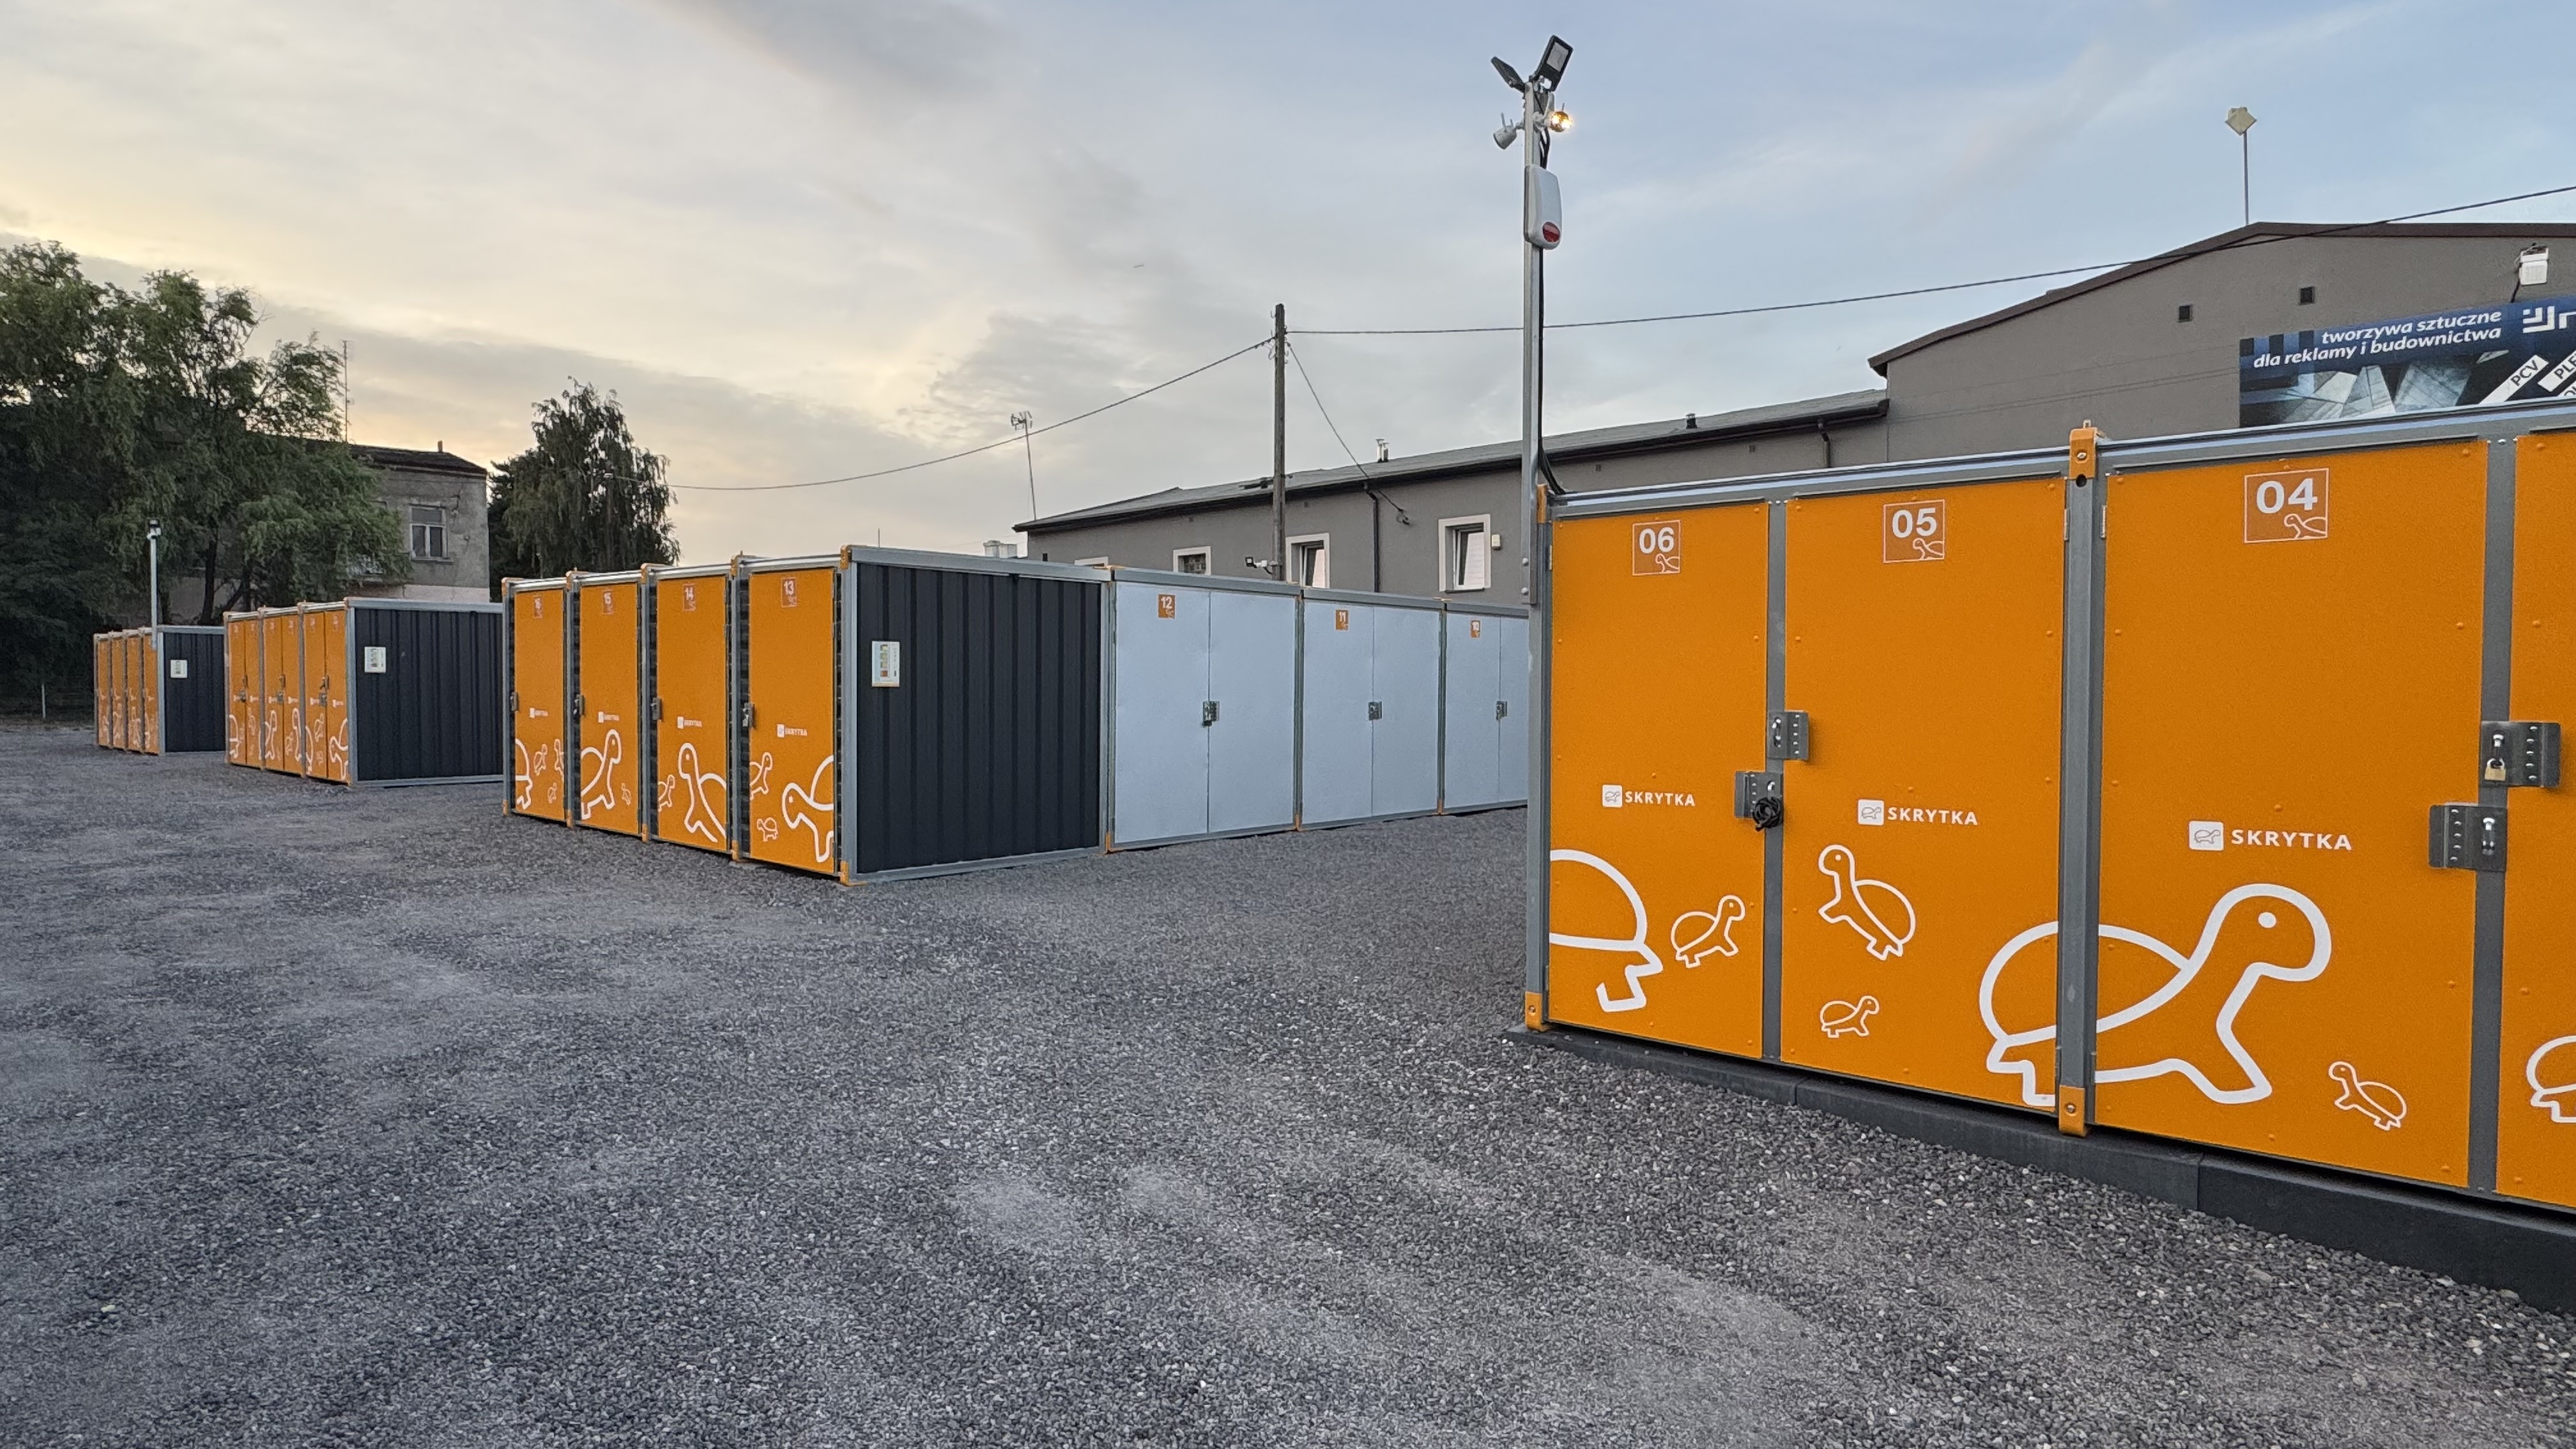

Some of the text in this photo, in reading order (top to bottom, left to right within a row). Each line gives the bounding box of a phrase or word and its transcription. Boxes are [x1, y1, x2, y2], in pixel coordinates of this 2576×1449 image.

[2322, 311, 2502, 344] tworzywa sztuczne
[2253, 327, 2502, 368] dla reklamy i budownictwa
[2510, 359, 2539, 387] PCV
[2554, 353, 2576, 379] PLE
[2255, 478, 2318, 514] 04
[1891, 508, 1938, 539] 05
[1639, 527, 1675, 555] 06
[784, 580, 794, 595] 13
[1161, 596, 1173, 609] 12
[1625, 791, 1696, 806] SKRYTKA
[1887, 806, 1978, 825] SKRYTKA
[2231, 829, 2352, 851] SKRYTKA
